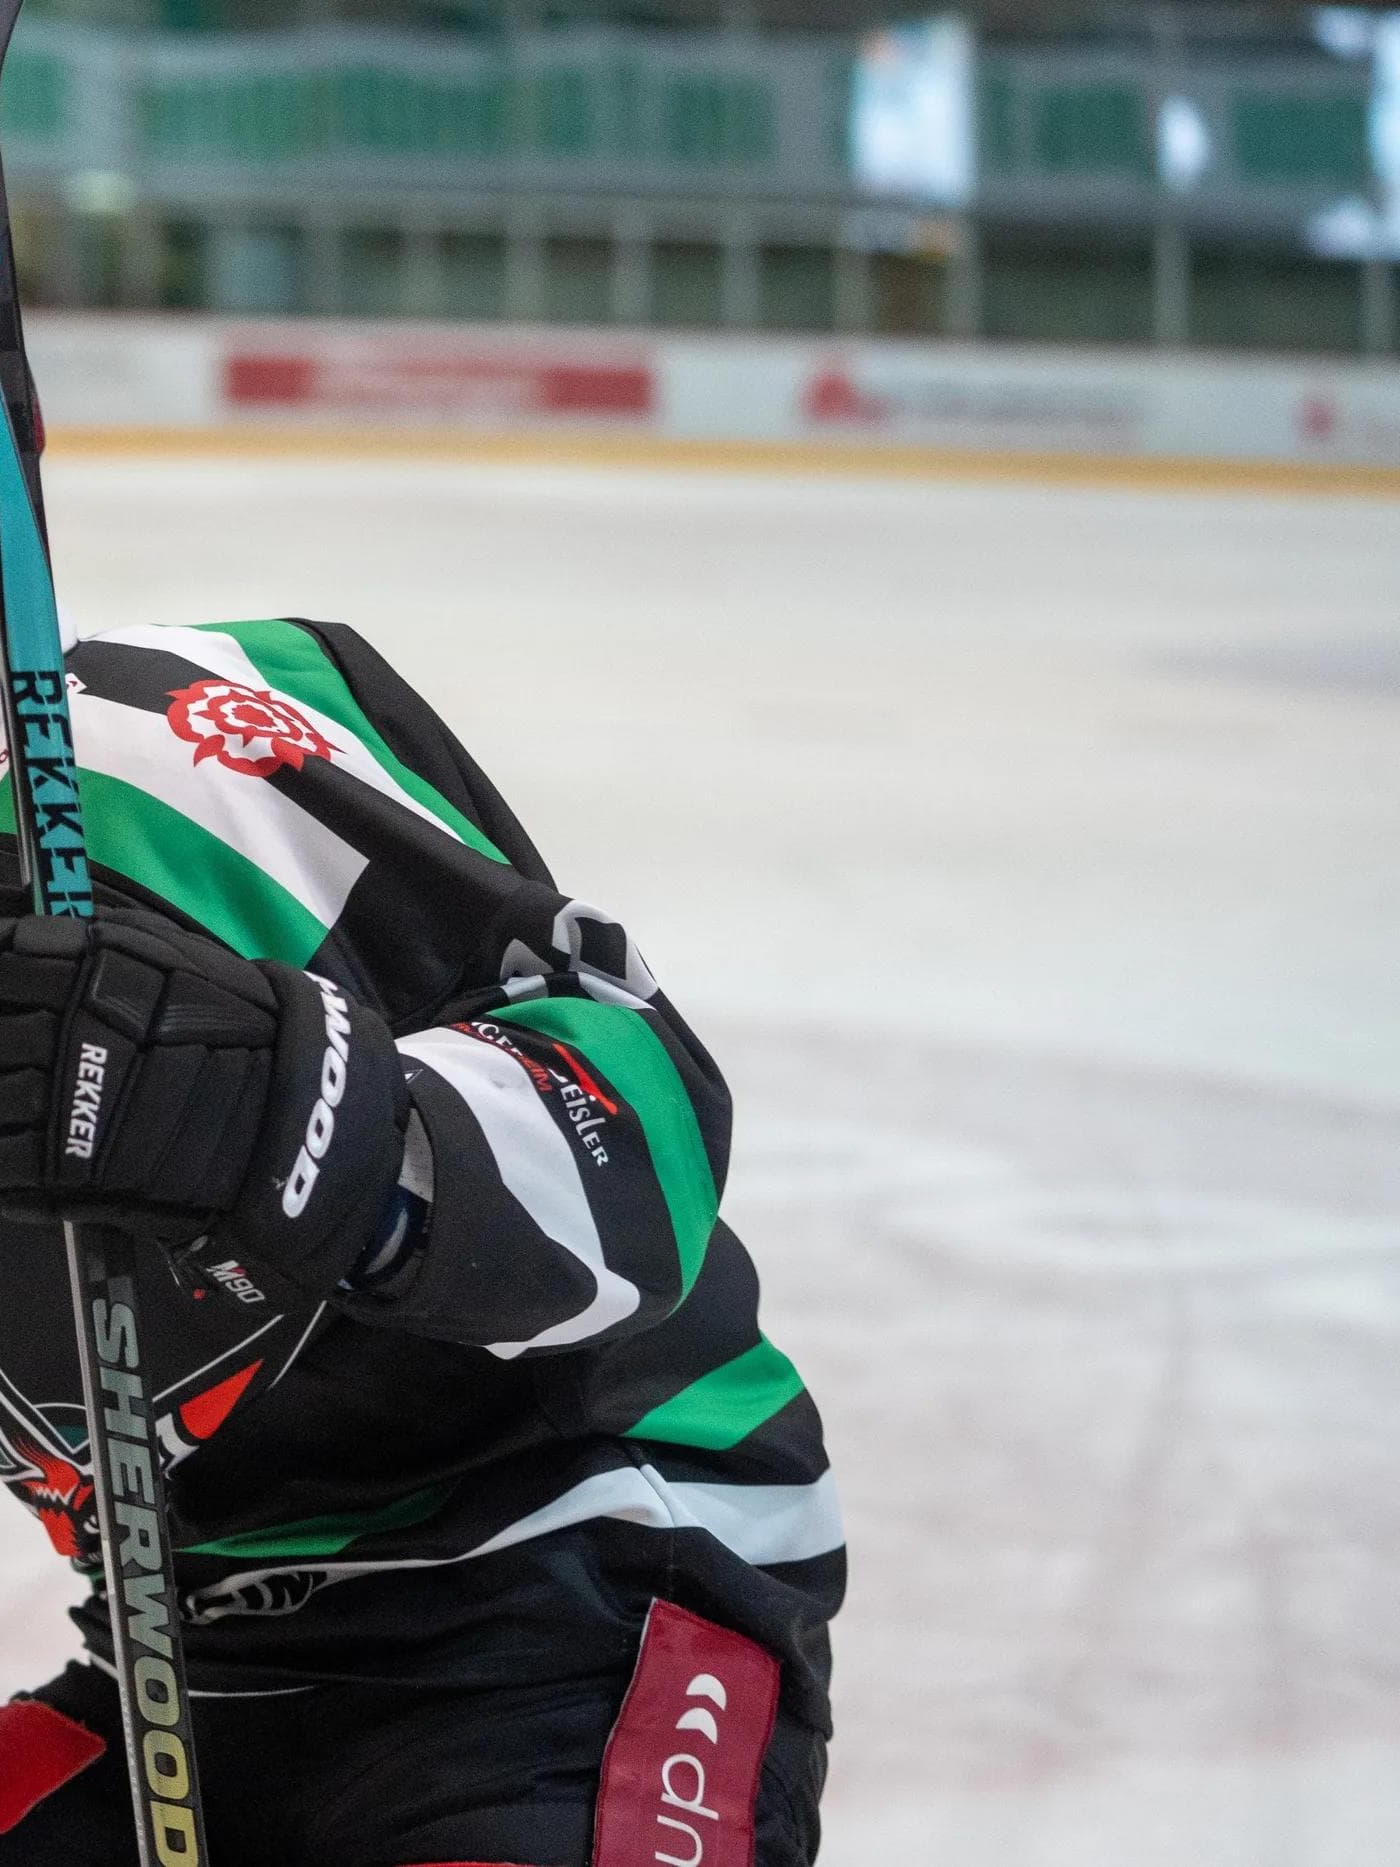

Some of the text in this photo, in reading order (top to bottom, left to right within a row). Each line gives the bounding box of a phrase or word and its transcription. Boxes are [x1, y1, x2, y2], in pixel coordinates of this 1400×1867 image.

[65, 1042, 108, 1159] REKKER
[282, 971, 351, 1219] WOOD
[92, 1297, 200, 1867] SHERWOOD
